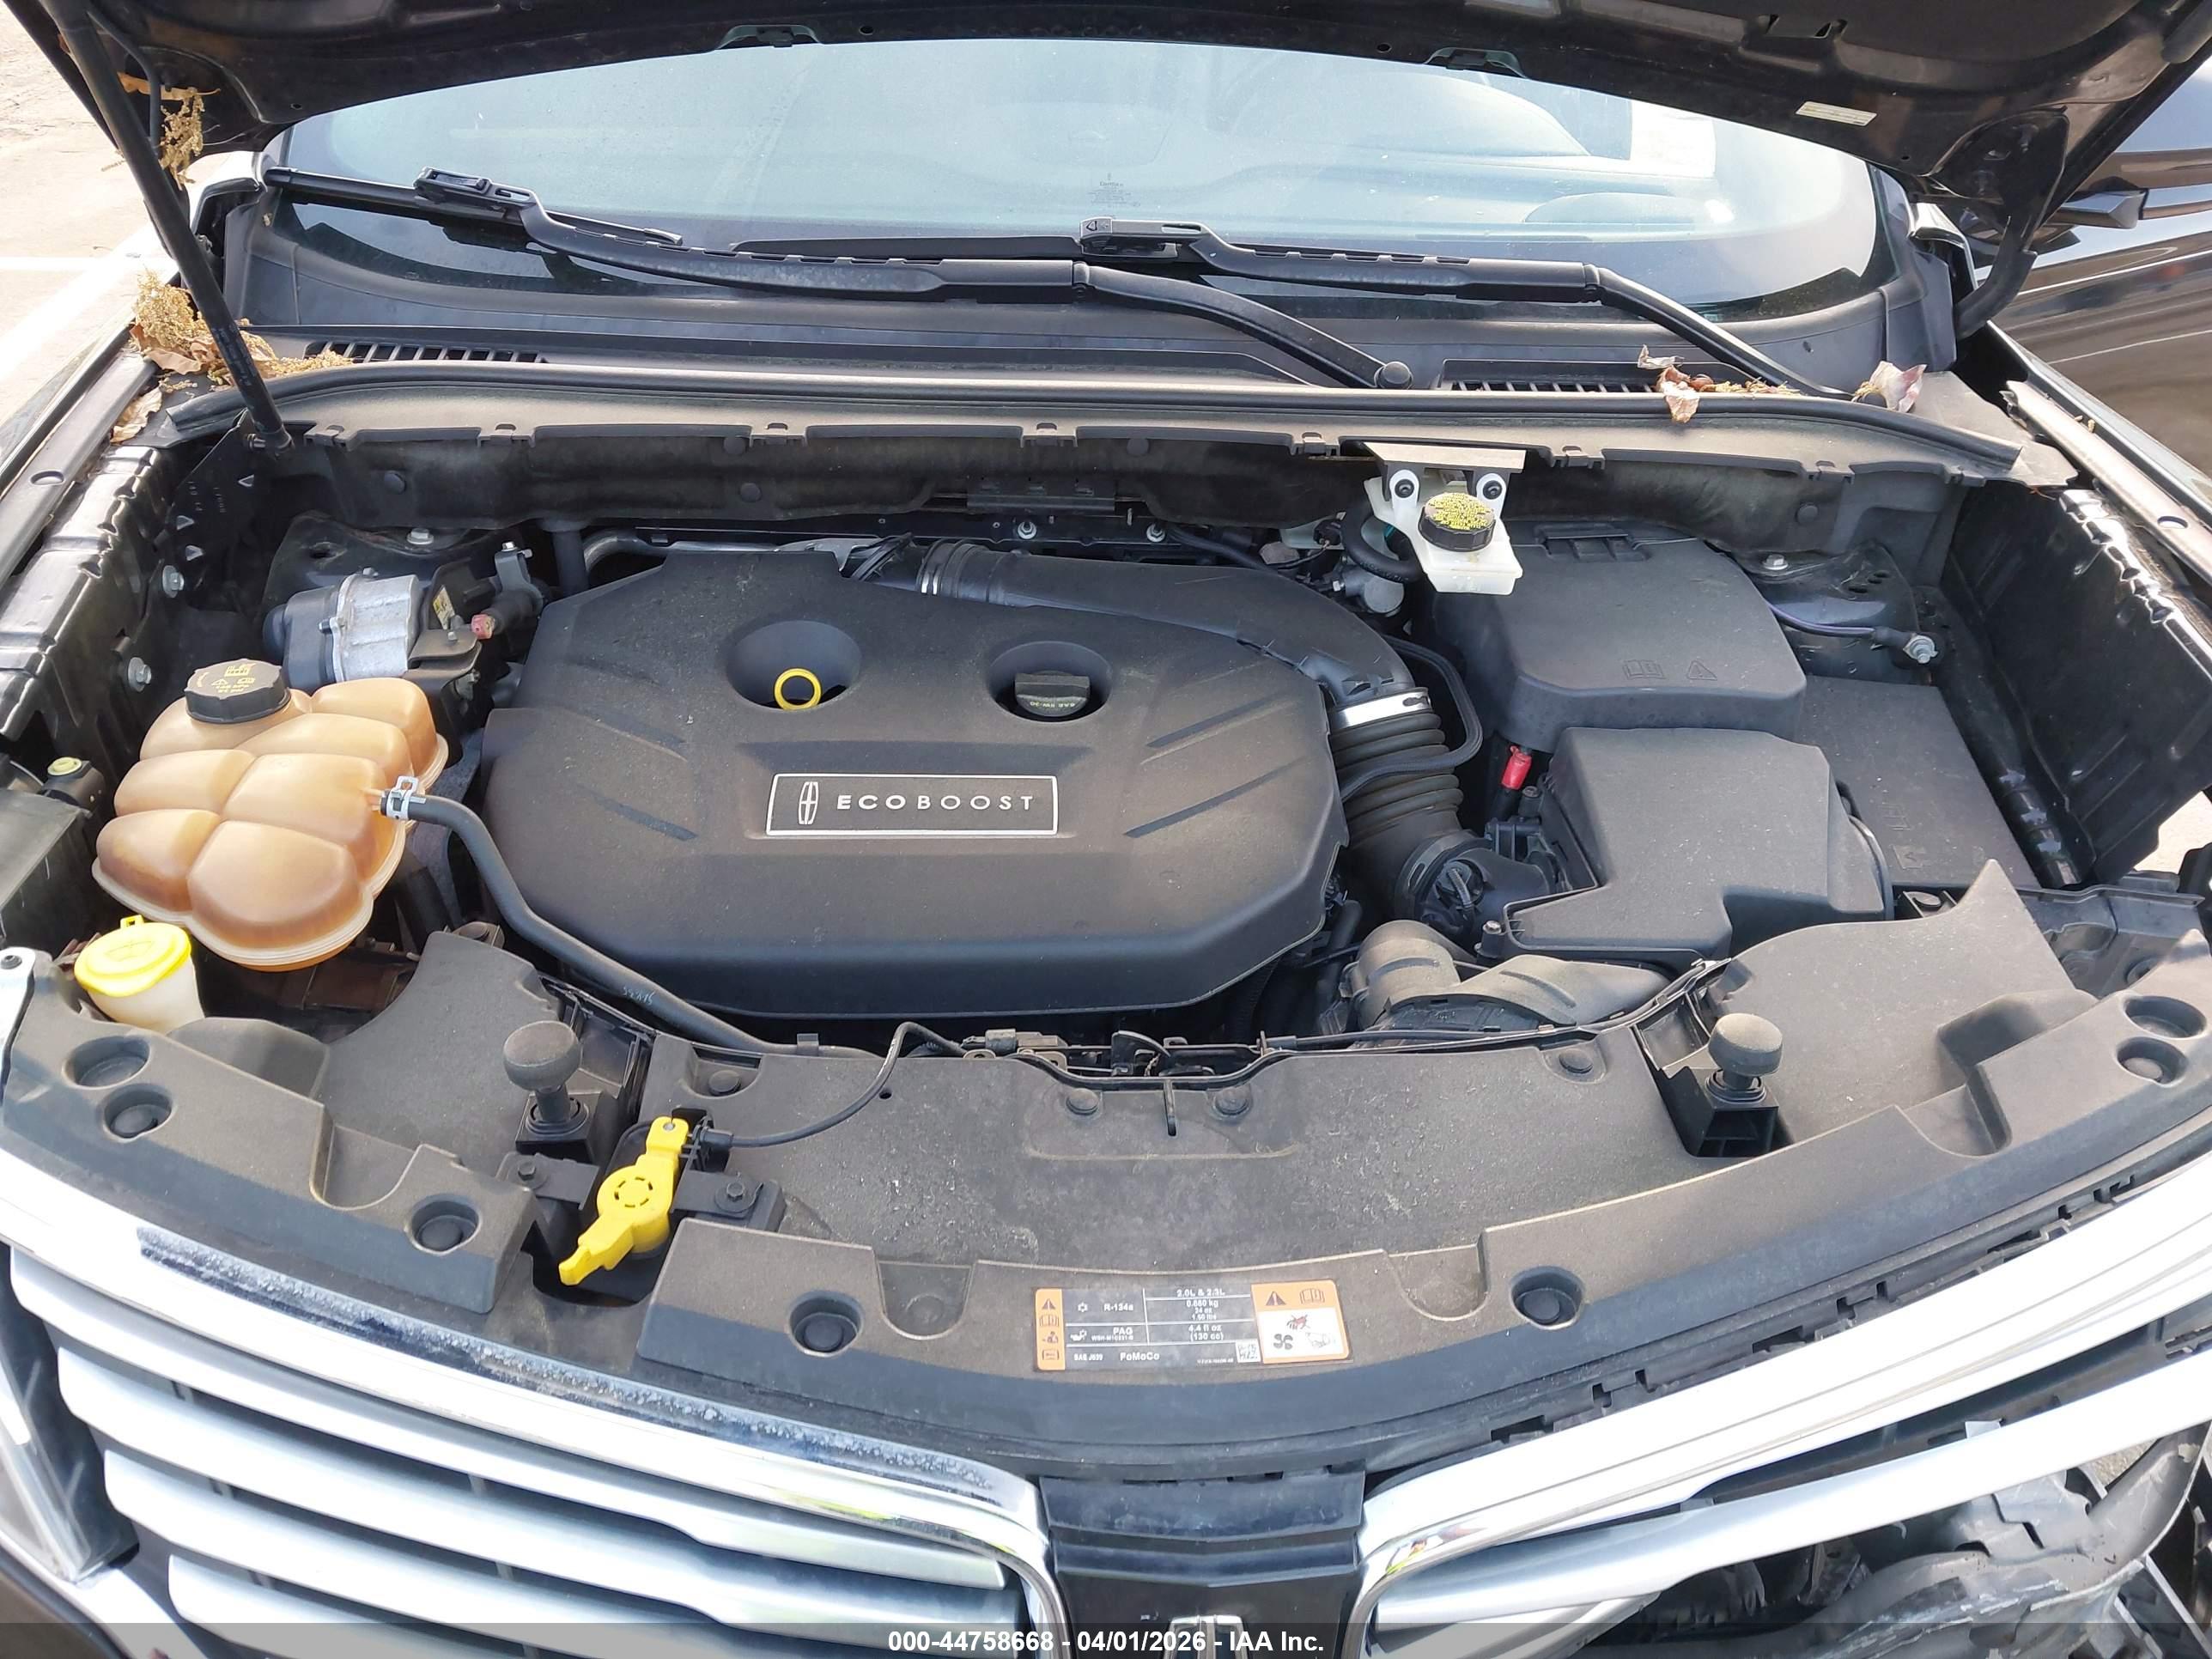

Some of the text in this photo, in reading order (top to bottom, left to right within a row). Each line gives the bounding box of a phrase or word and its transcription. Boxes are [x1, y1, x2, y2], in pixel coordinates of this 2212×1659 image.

[836, 794, 1034, 811] ECOBOOST
[1176, 1288, 1196, 1297] 2.0L
[1103, 1303, 1134, 1312] R-134a
[1208, 1298, 1219, 1308] kg
[1113, 1326, 1133, 1335] PAG
[1120, 1351, 1160, 1361] FoMoCo
